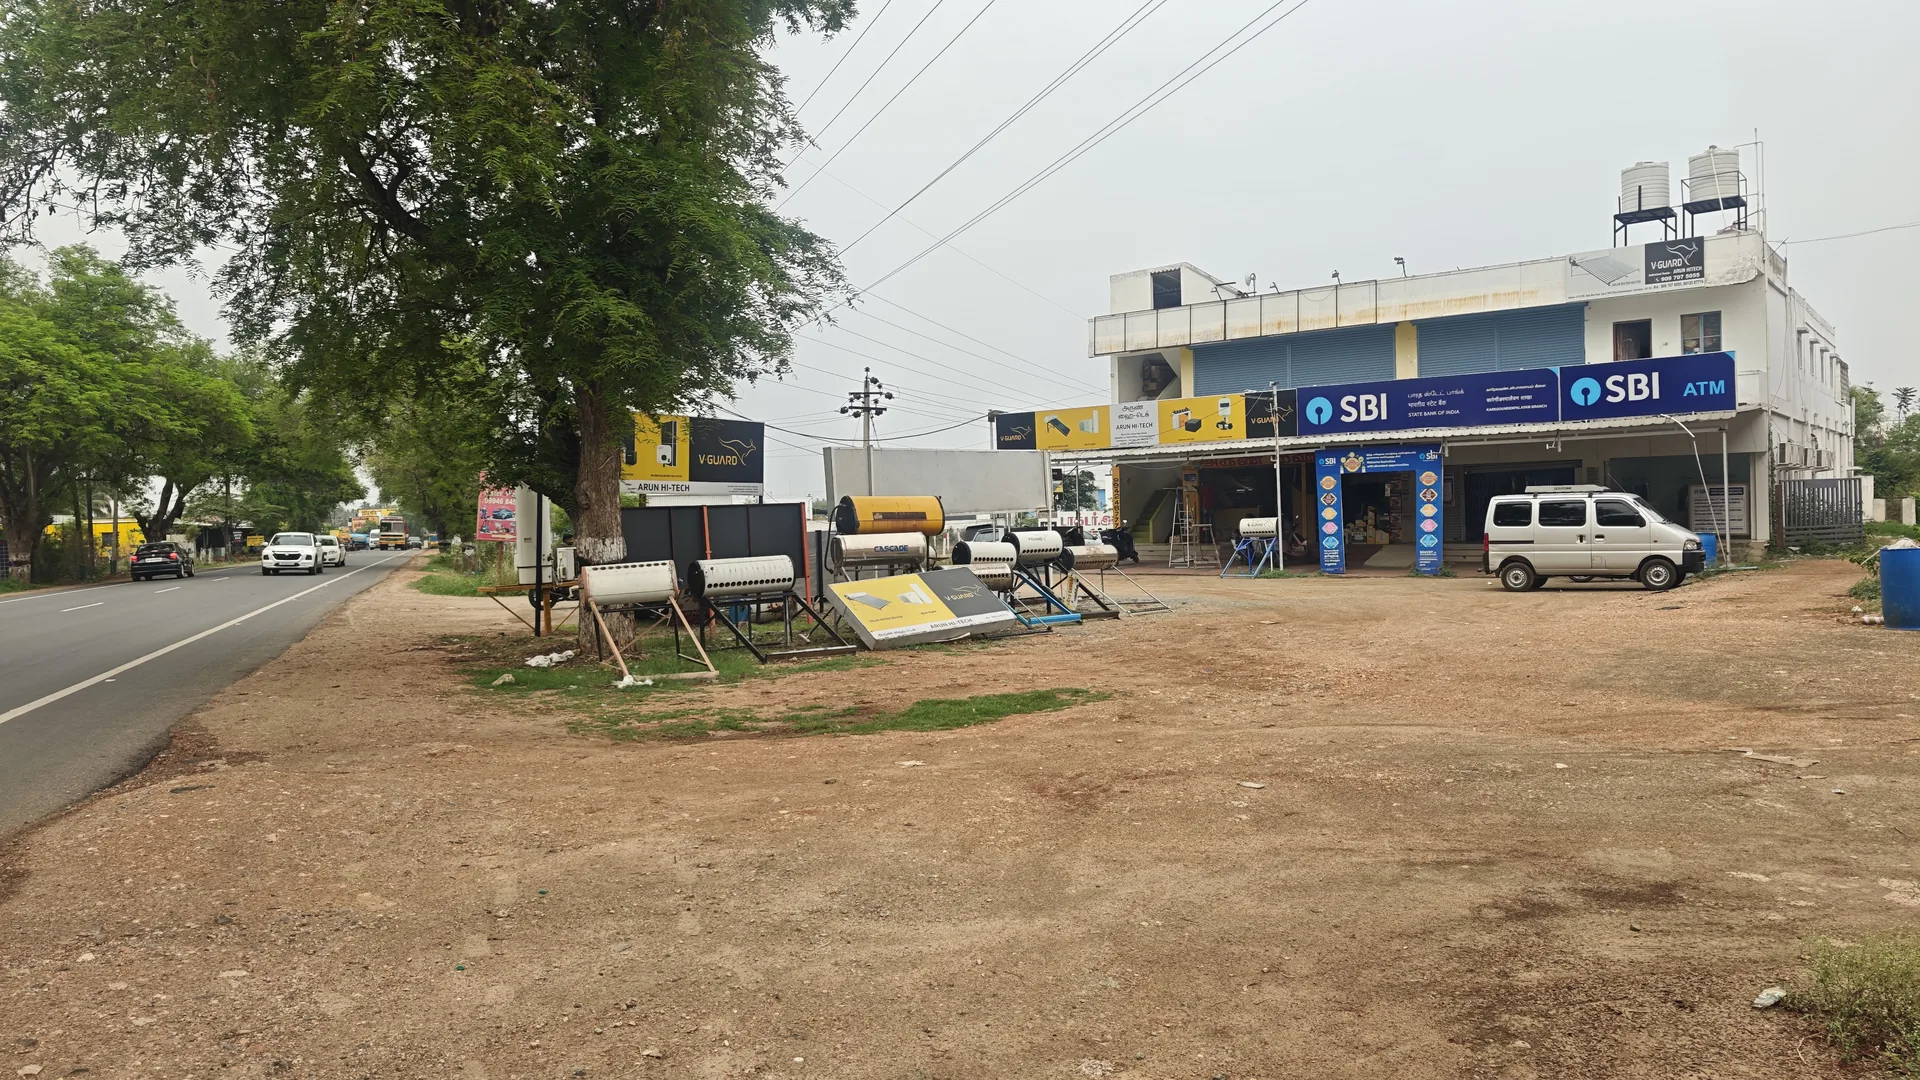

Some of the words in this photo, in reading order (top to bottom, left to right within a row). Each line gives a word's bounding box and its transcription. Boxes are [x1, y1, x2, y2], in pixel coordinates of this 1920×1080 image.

[1651, 258, 1682, 269] V-GUARD
[1606, 372, 1660, 403] SBI
[1683, 380, 1725, 396] ATM
[1340, 393, 1388, 423] SBI
[699, 454, 737, 466] V-GUARD
[638, 483, 659, 492] ARUN
[661, 484, 690, 492] HI-TECH
[945, 592, 974, 601] V-GUARD
[930, 622, 948, 630] ARUN
[949, 618, 973, 627] HI-TECH
